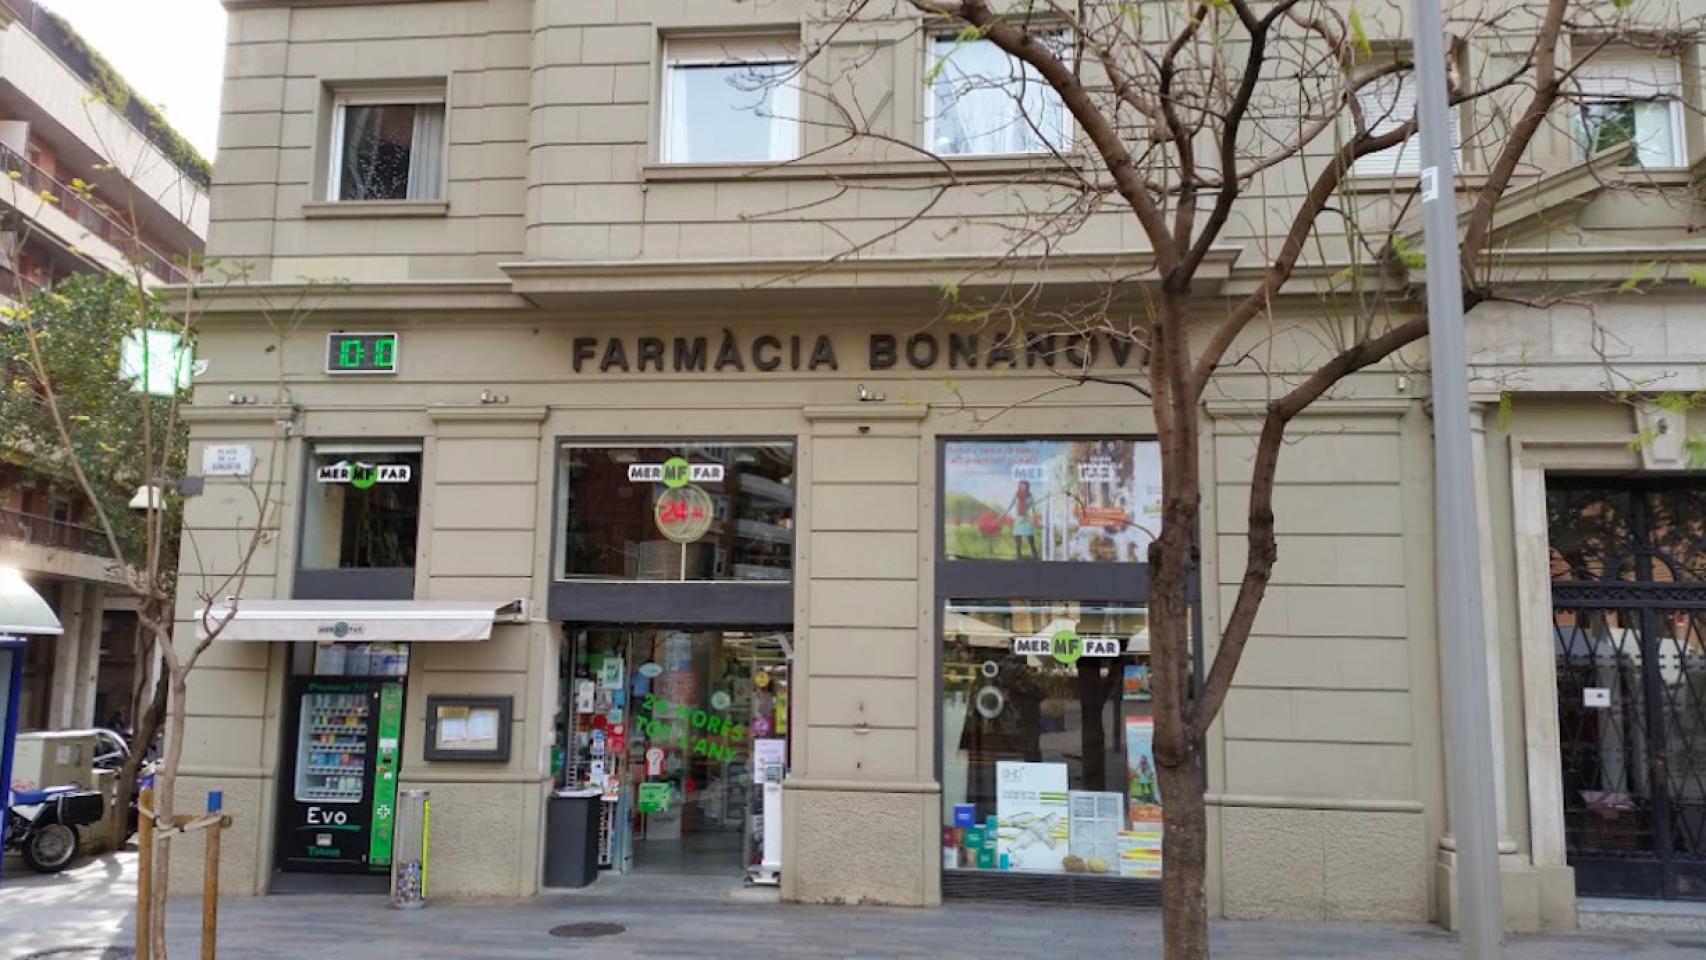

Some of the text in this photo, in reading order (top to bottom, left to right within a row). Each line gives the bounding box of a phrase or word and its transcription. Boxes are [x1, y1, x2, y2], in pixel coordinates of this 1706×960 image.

[572, 328, 1151, 373] FARMÀCIA BONANOV
[321, 469, 348, 479] MER
[382, 469, 407, 479] FAR
[631, 465, 720, 480] MER MF FAR
[1017, 639, 1116, 654] MER MF FAR
[307, 806, 348, 825] Evo
